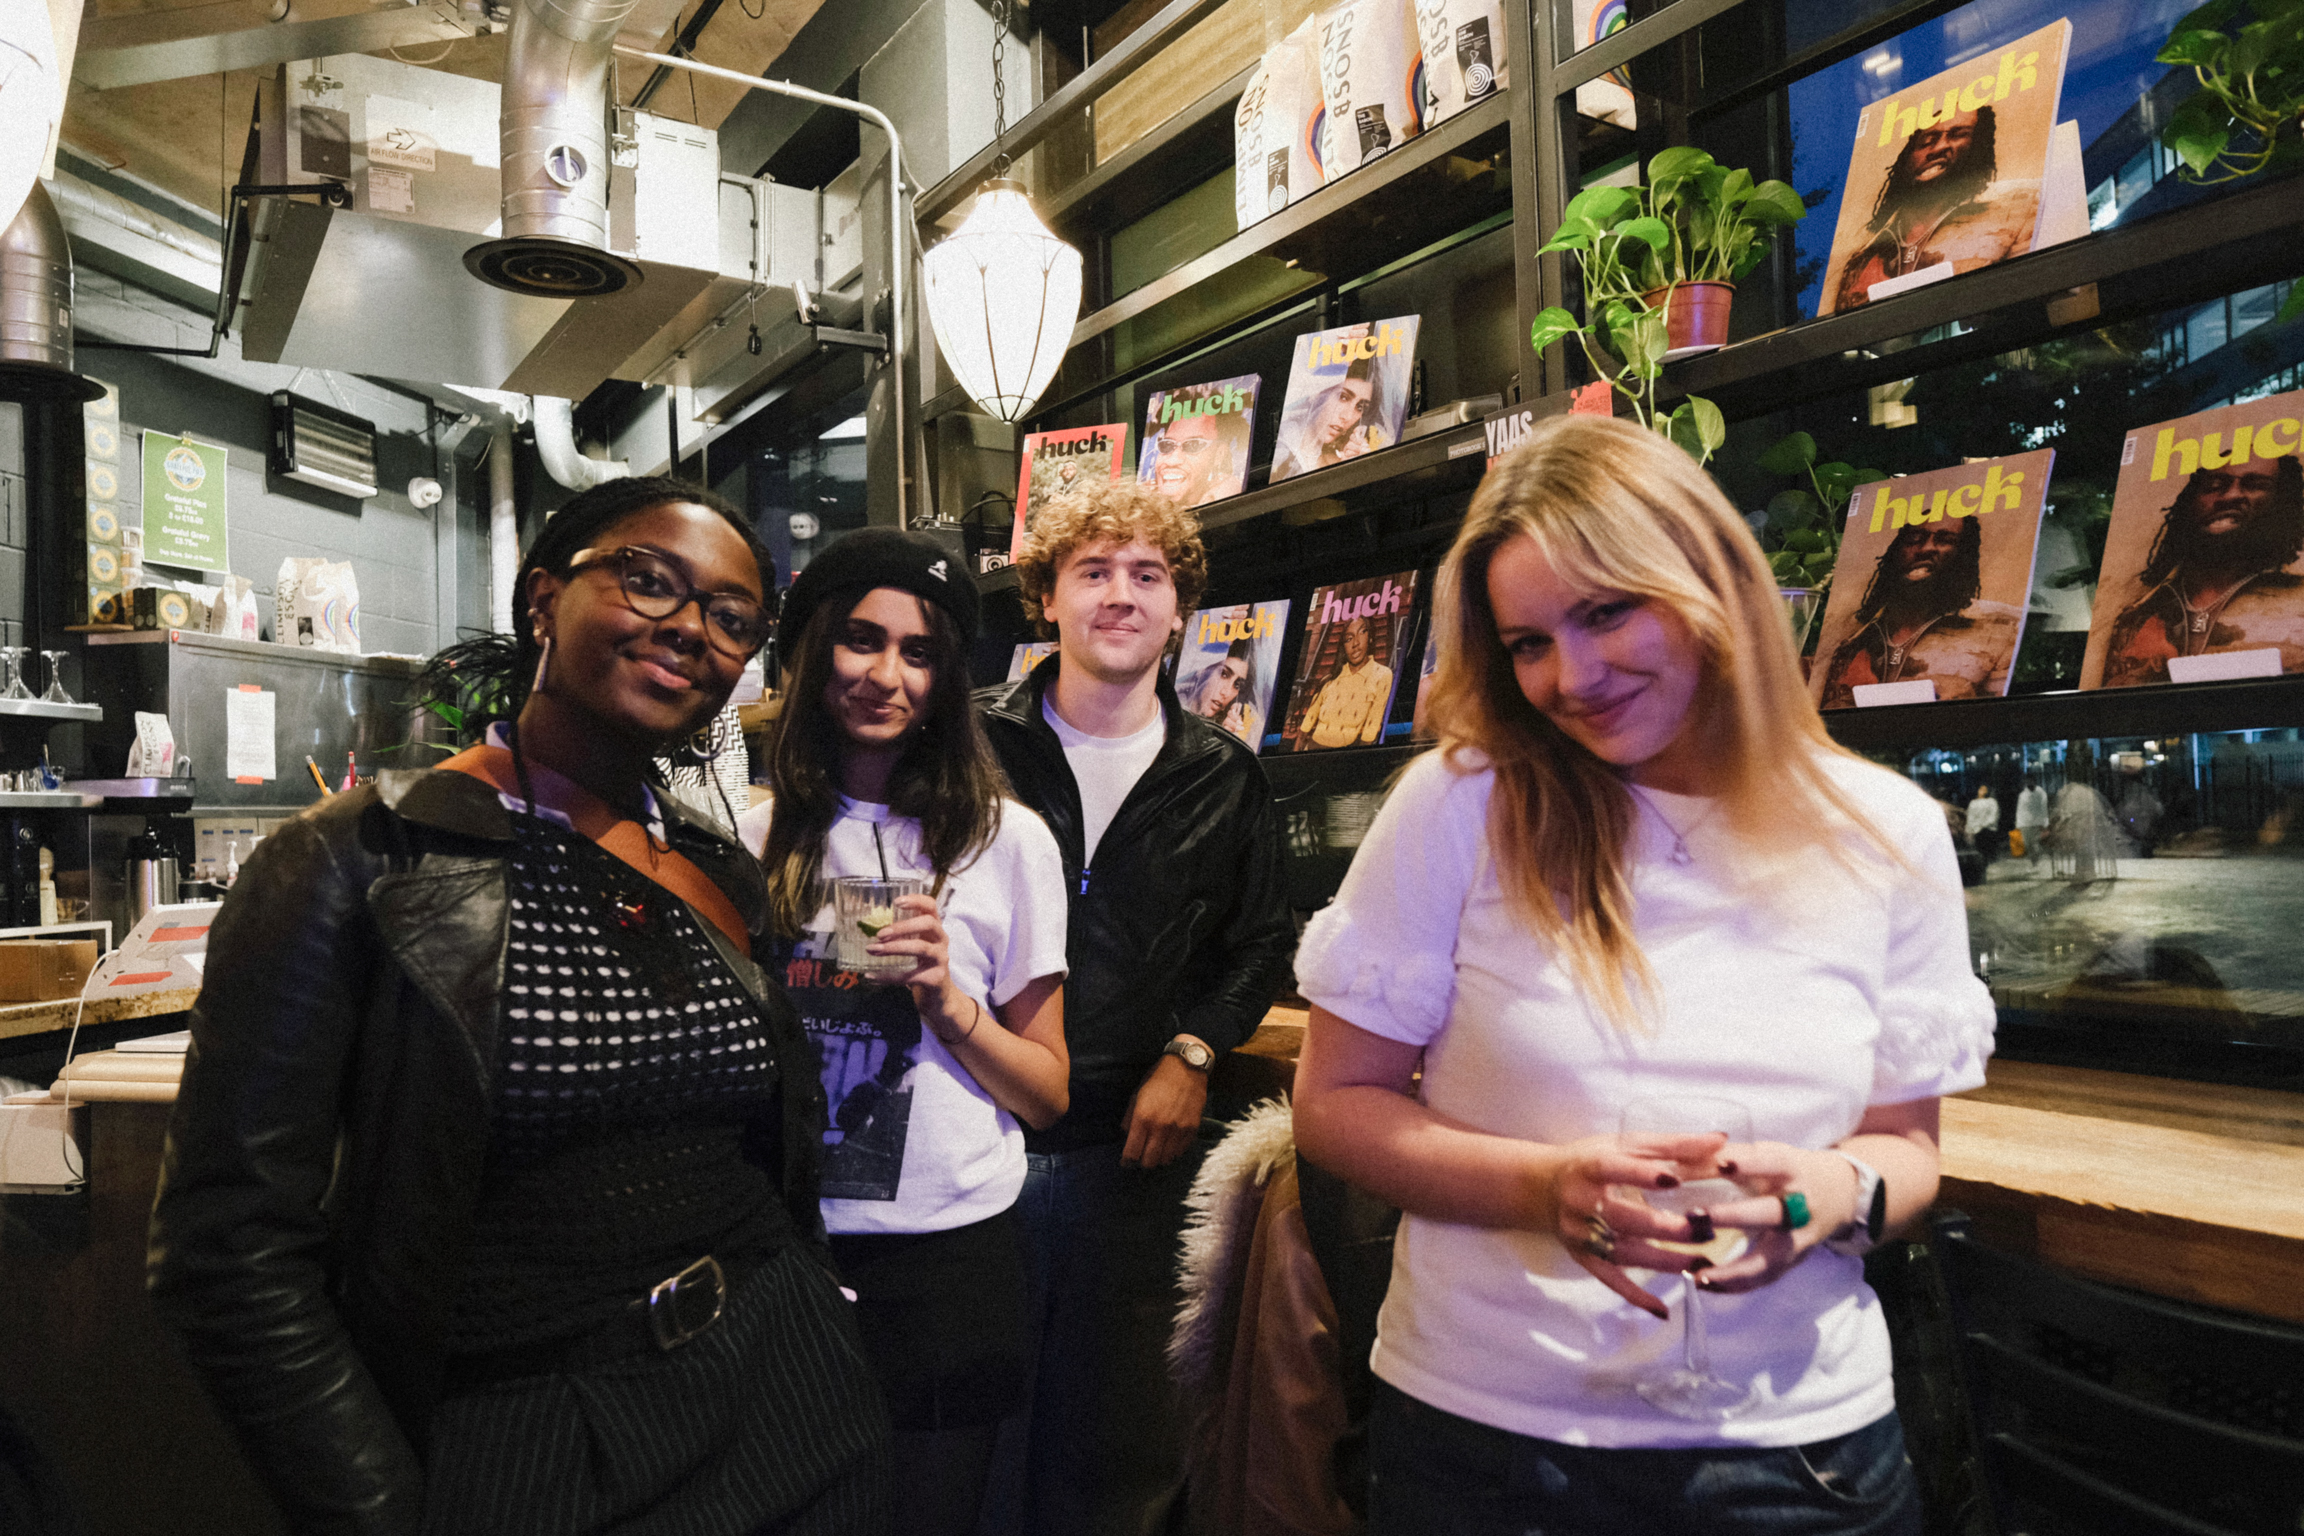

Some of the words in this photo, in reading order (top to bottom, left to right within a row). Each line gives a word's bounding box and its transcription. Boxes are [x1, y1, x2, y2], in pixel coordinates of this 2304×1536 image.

[1878, 50, 2040, 148] huck
[371, 148, 381, 157] AIR
[382, 151, 400, 159] FLOW
[402, 154, 433, 165] DIRECTION
[1308, 323, 1404, 369] huck
[1160, 383, 1245, 424] huck
[1039, 431, 1107, 460] huck
[1485, 410, 1533, 457] YAAS
[2150, 418, 2304, 482] huc
[1868, 465, 2025, 533] huck
[190, 530, 210, 542] Gravy
[1320, 580, 1402, 625] huck
[1197, 607, 1276, 645] huck
